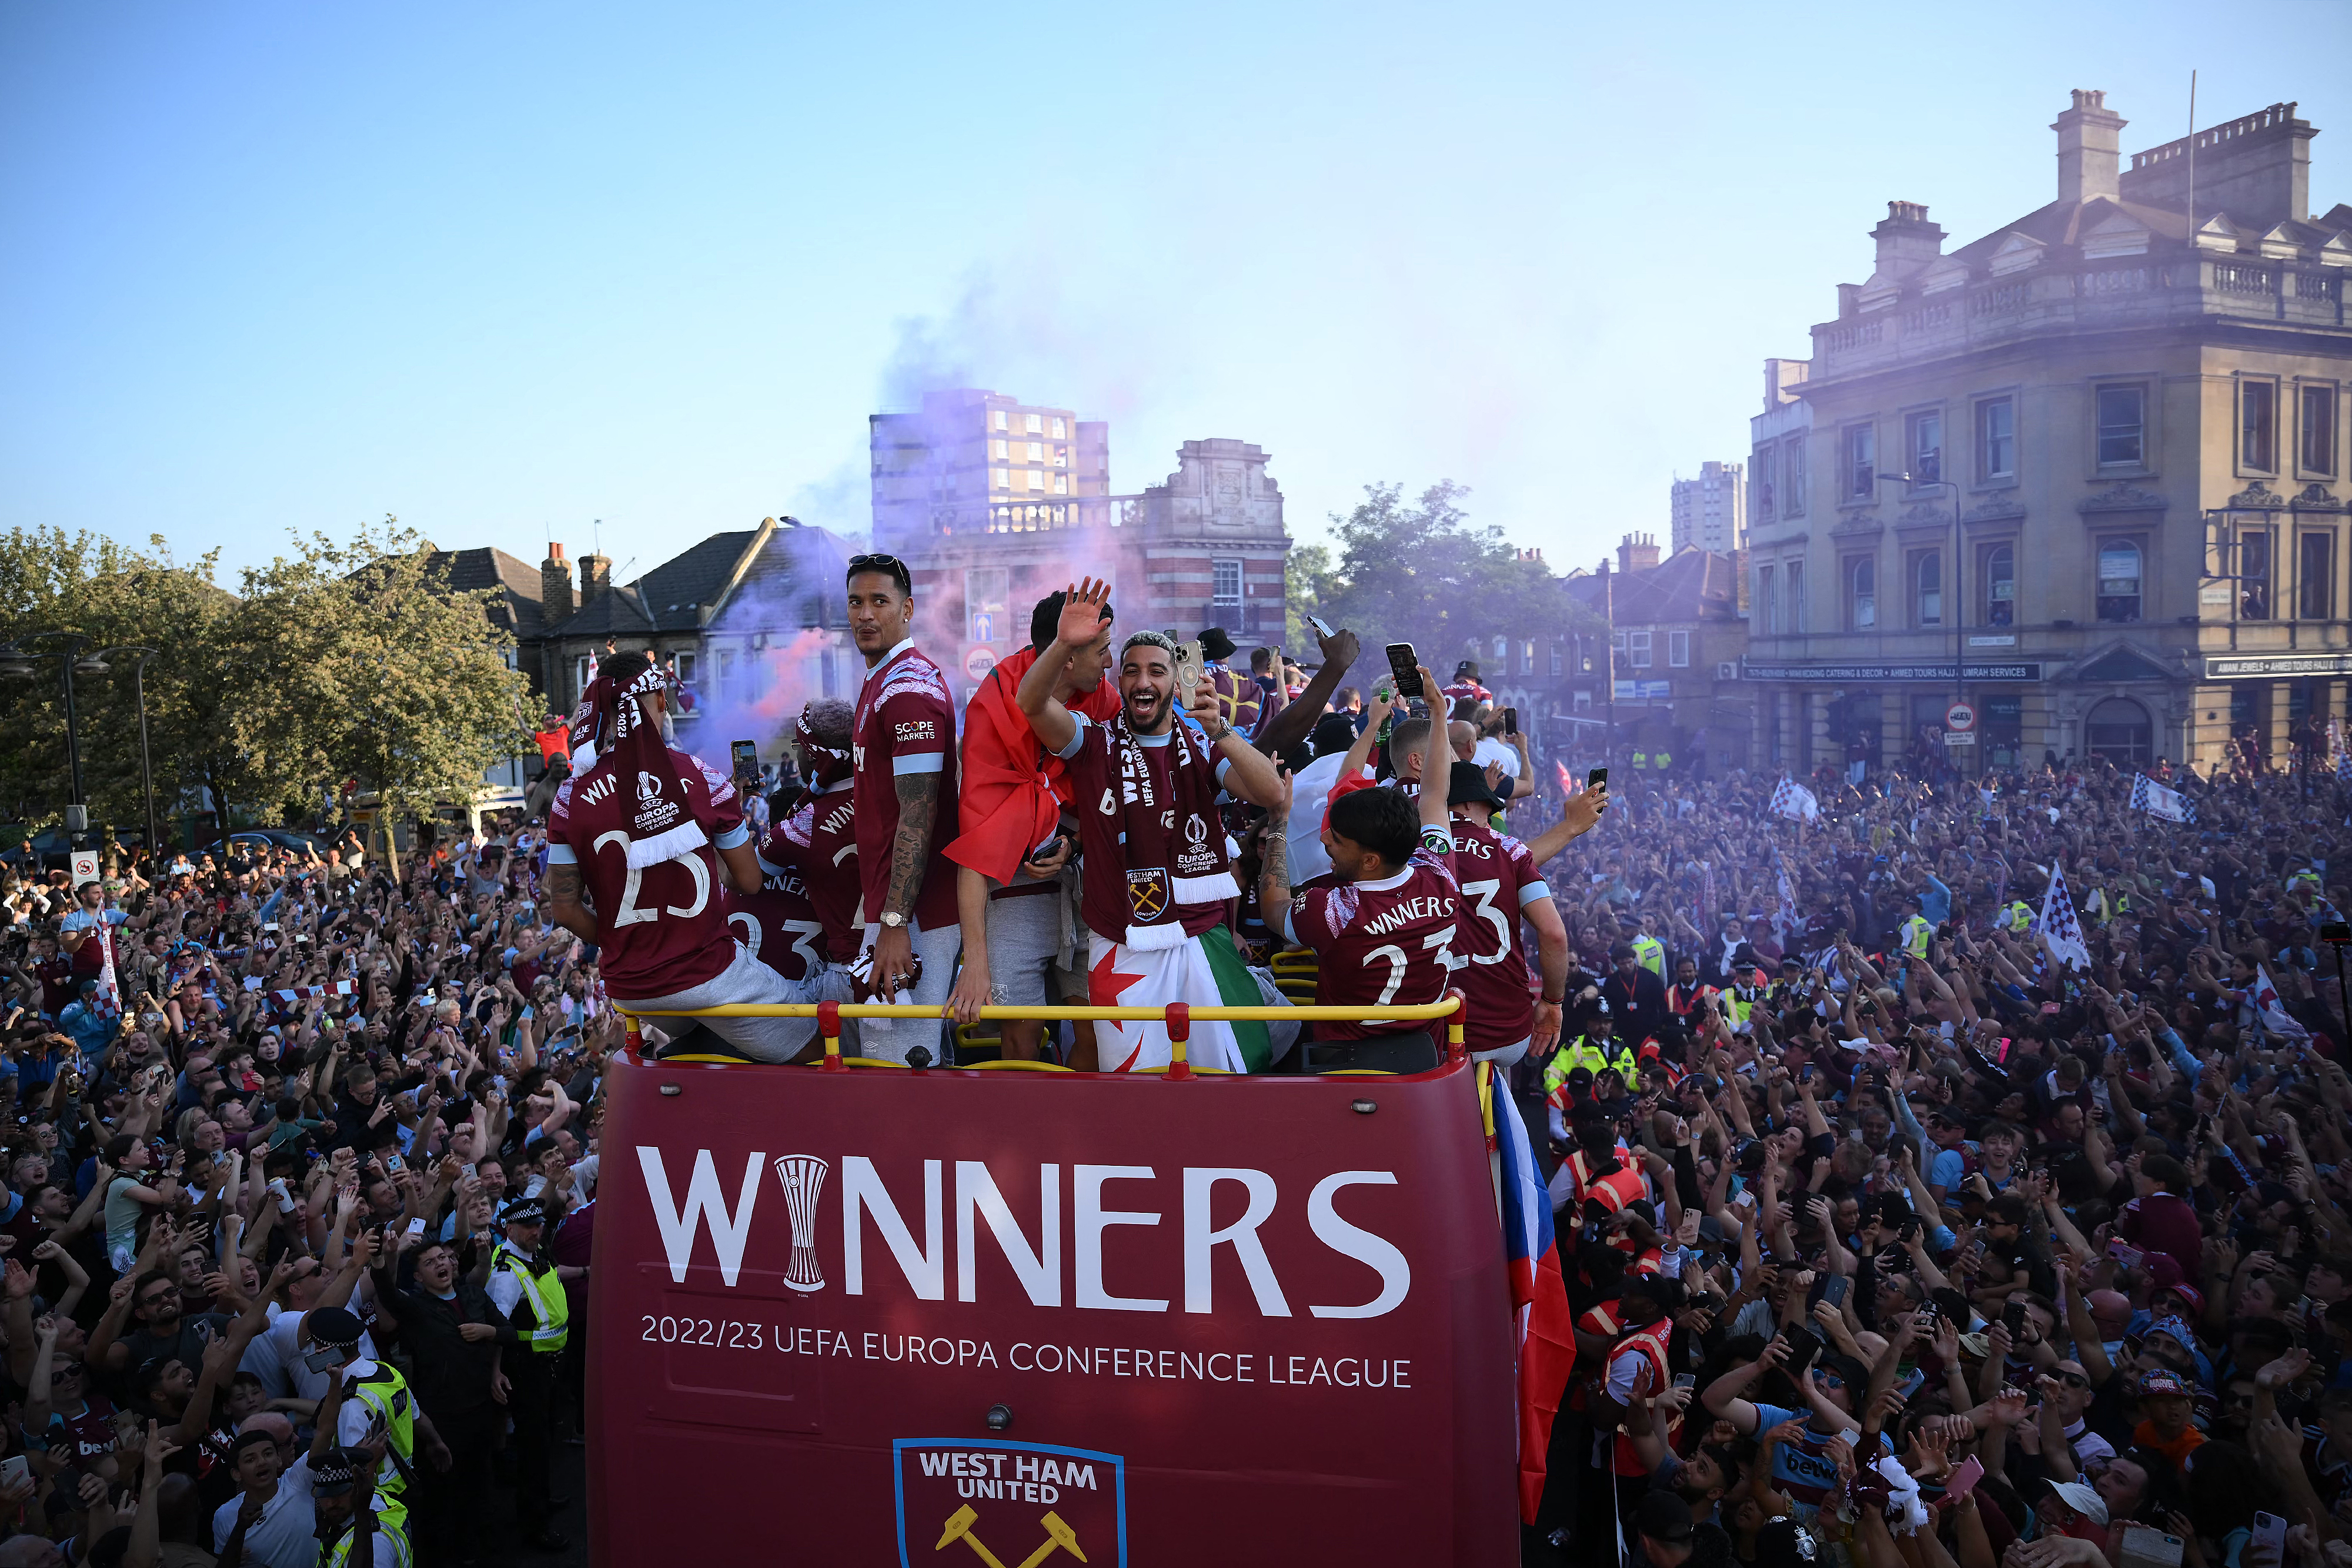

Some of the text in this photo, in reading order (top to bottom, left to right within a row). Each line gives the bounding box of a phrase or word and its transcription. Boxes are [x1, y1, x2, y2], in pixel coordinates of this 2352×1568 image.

[1826, 669, 1855, 678] CATERING
[1862, 669, 1884, 678] DECOR
[1890, 668, 1913, 677] AHMED
[1915, 668, 1936, 677] TOURS
[1938, 668, 1956, 677] HAJJ
[1963, 668, 1988, 677] UMRAH
[1990, 667, 2026, 677] SERVICES
[2219, 663, 2238, 673] AMANI
[2239, 662, 2264, 673] JEWELS
[2271, 661, 2293, 671] AHMED
[2293, 661, 2313, 671] TOURS
[2314, 661, 2328, 670] HAJJ
[617, 713, 627, 738] 2023
[895, 721, 934, 734] SCOPE
[897, 731, 935, 743] MARKETS
[1131, 741, 1154, 807] UEFA EUROPA
[642, 800, 663, 810] UEFA
[634, 802, 679, 823] EUROPA
[636, 808, 680, 829] CONFERENCE
[646, 817, 674, 831] LEAGUE
[1190, 845, 1207, 854] UEFA
[1177, 858, 1218, 869] CONFERENCE
[1178, 850, 1217, 864] EUROPA
[1142, 870, 1161, 878] HAM
[1185, 865, 1211, 874] LEAGUE
[106, 954, 110, 963] ON
[642, 1316, 1411, 1389] 2022/23 UEFA EUROPA CONFERENCE LEAGUE
[2149, 1379, 2175, 1389] MARVEL
[920, 1452, 1097, 1490] WEST HAM
[1787, 1453, 1838, 1480] betw
[957, 1479, 1059, 1504] UNITED
